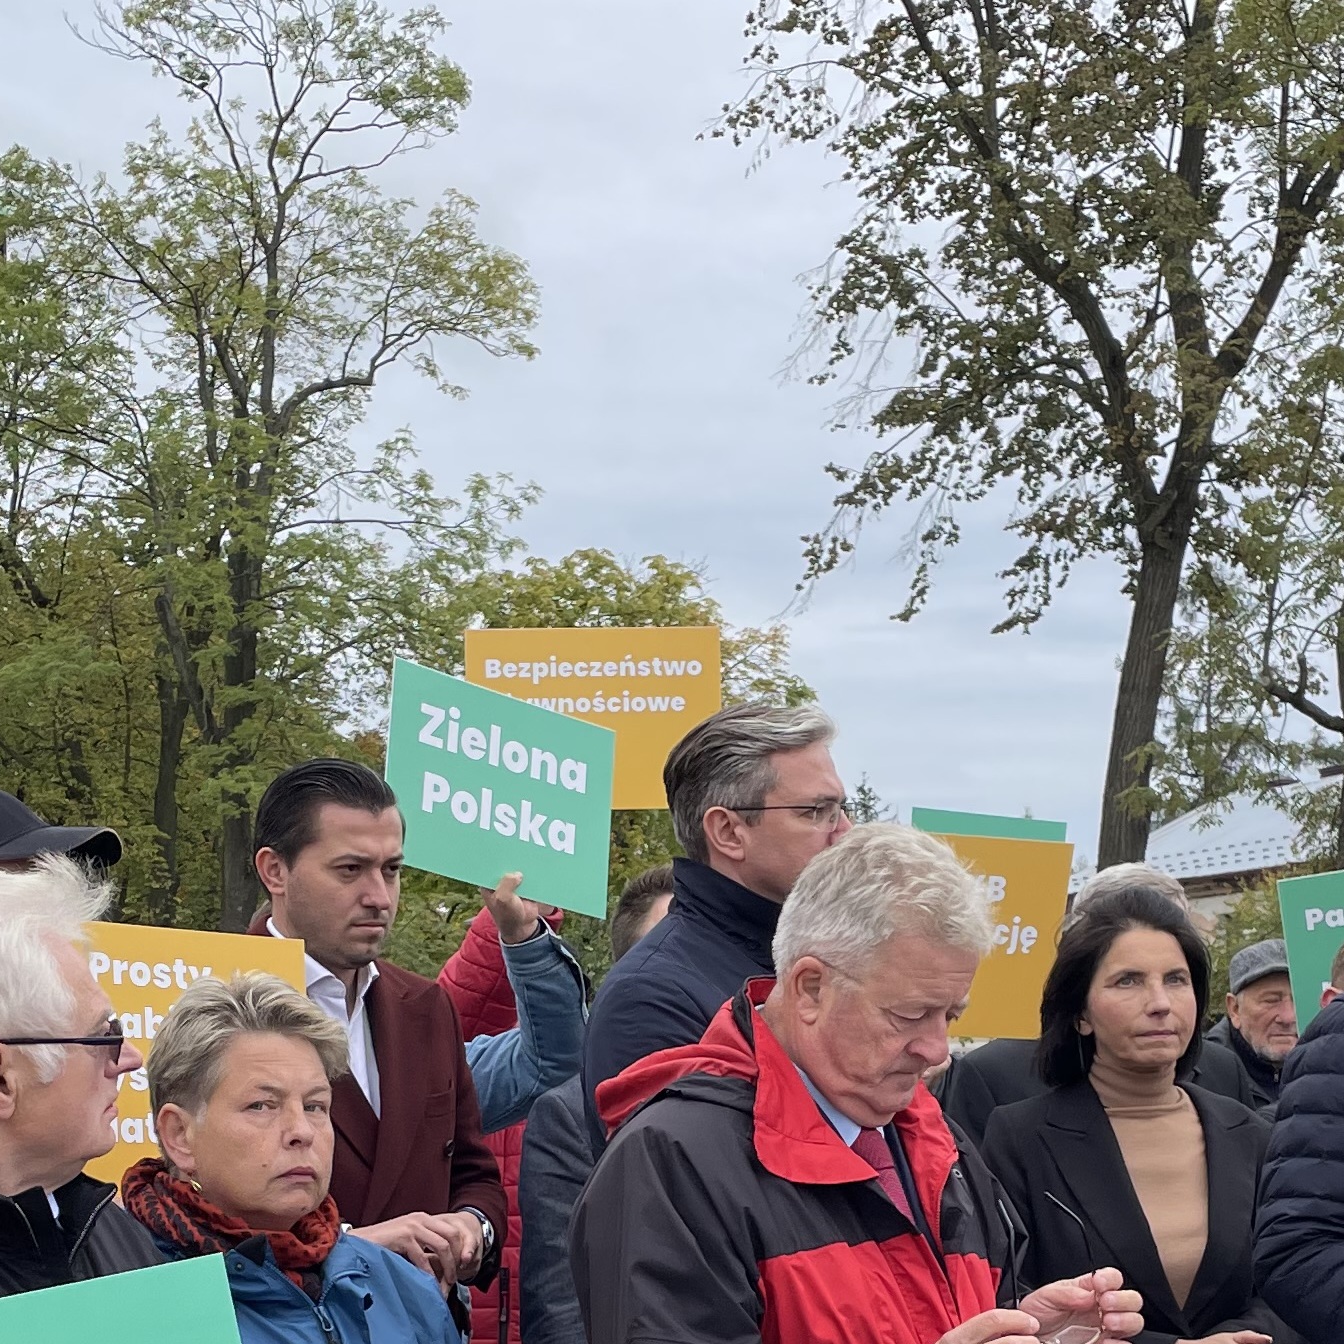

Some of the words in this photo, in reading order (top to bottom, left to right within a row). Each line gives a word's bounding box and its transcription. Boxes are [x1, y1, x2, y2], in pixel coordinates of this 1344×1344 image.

[484, 654, 703, 685] Bezpieczeństwo
[508, 690, 686, 714] wnościowe
[418, 702, 589, 795] Zielona
[421, 770, 577, 856] Polska
